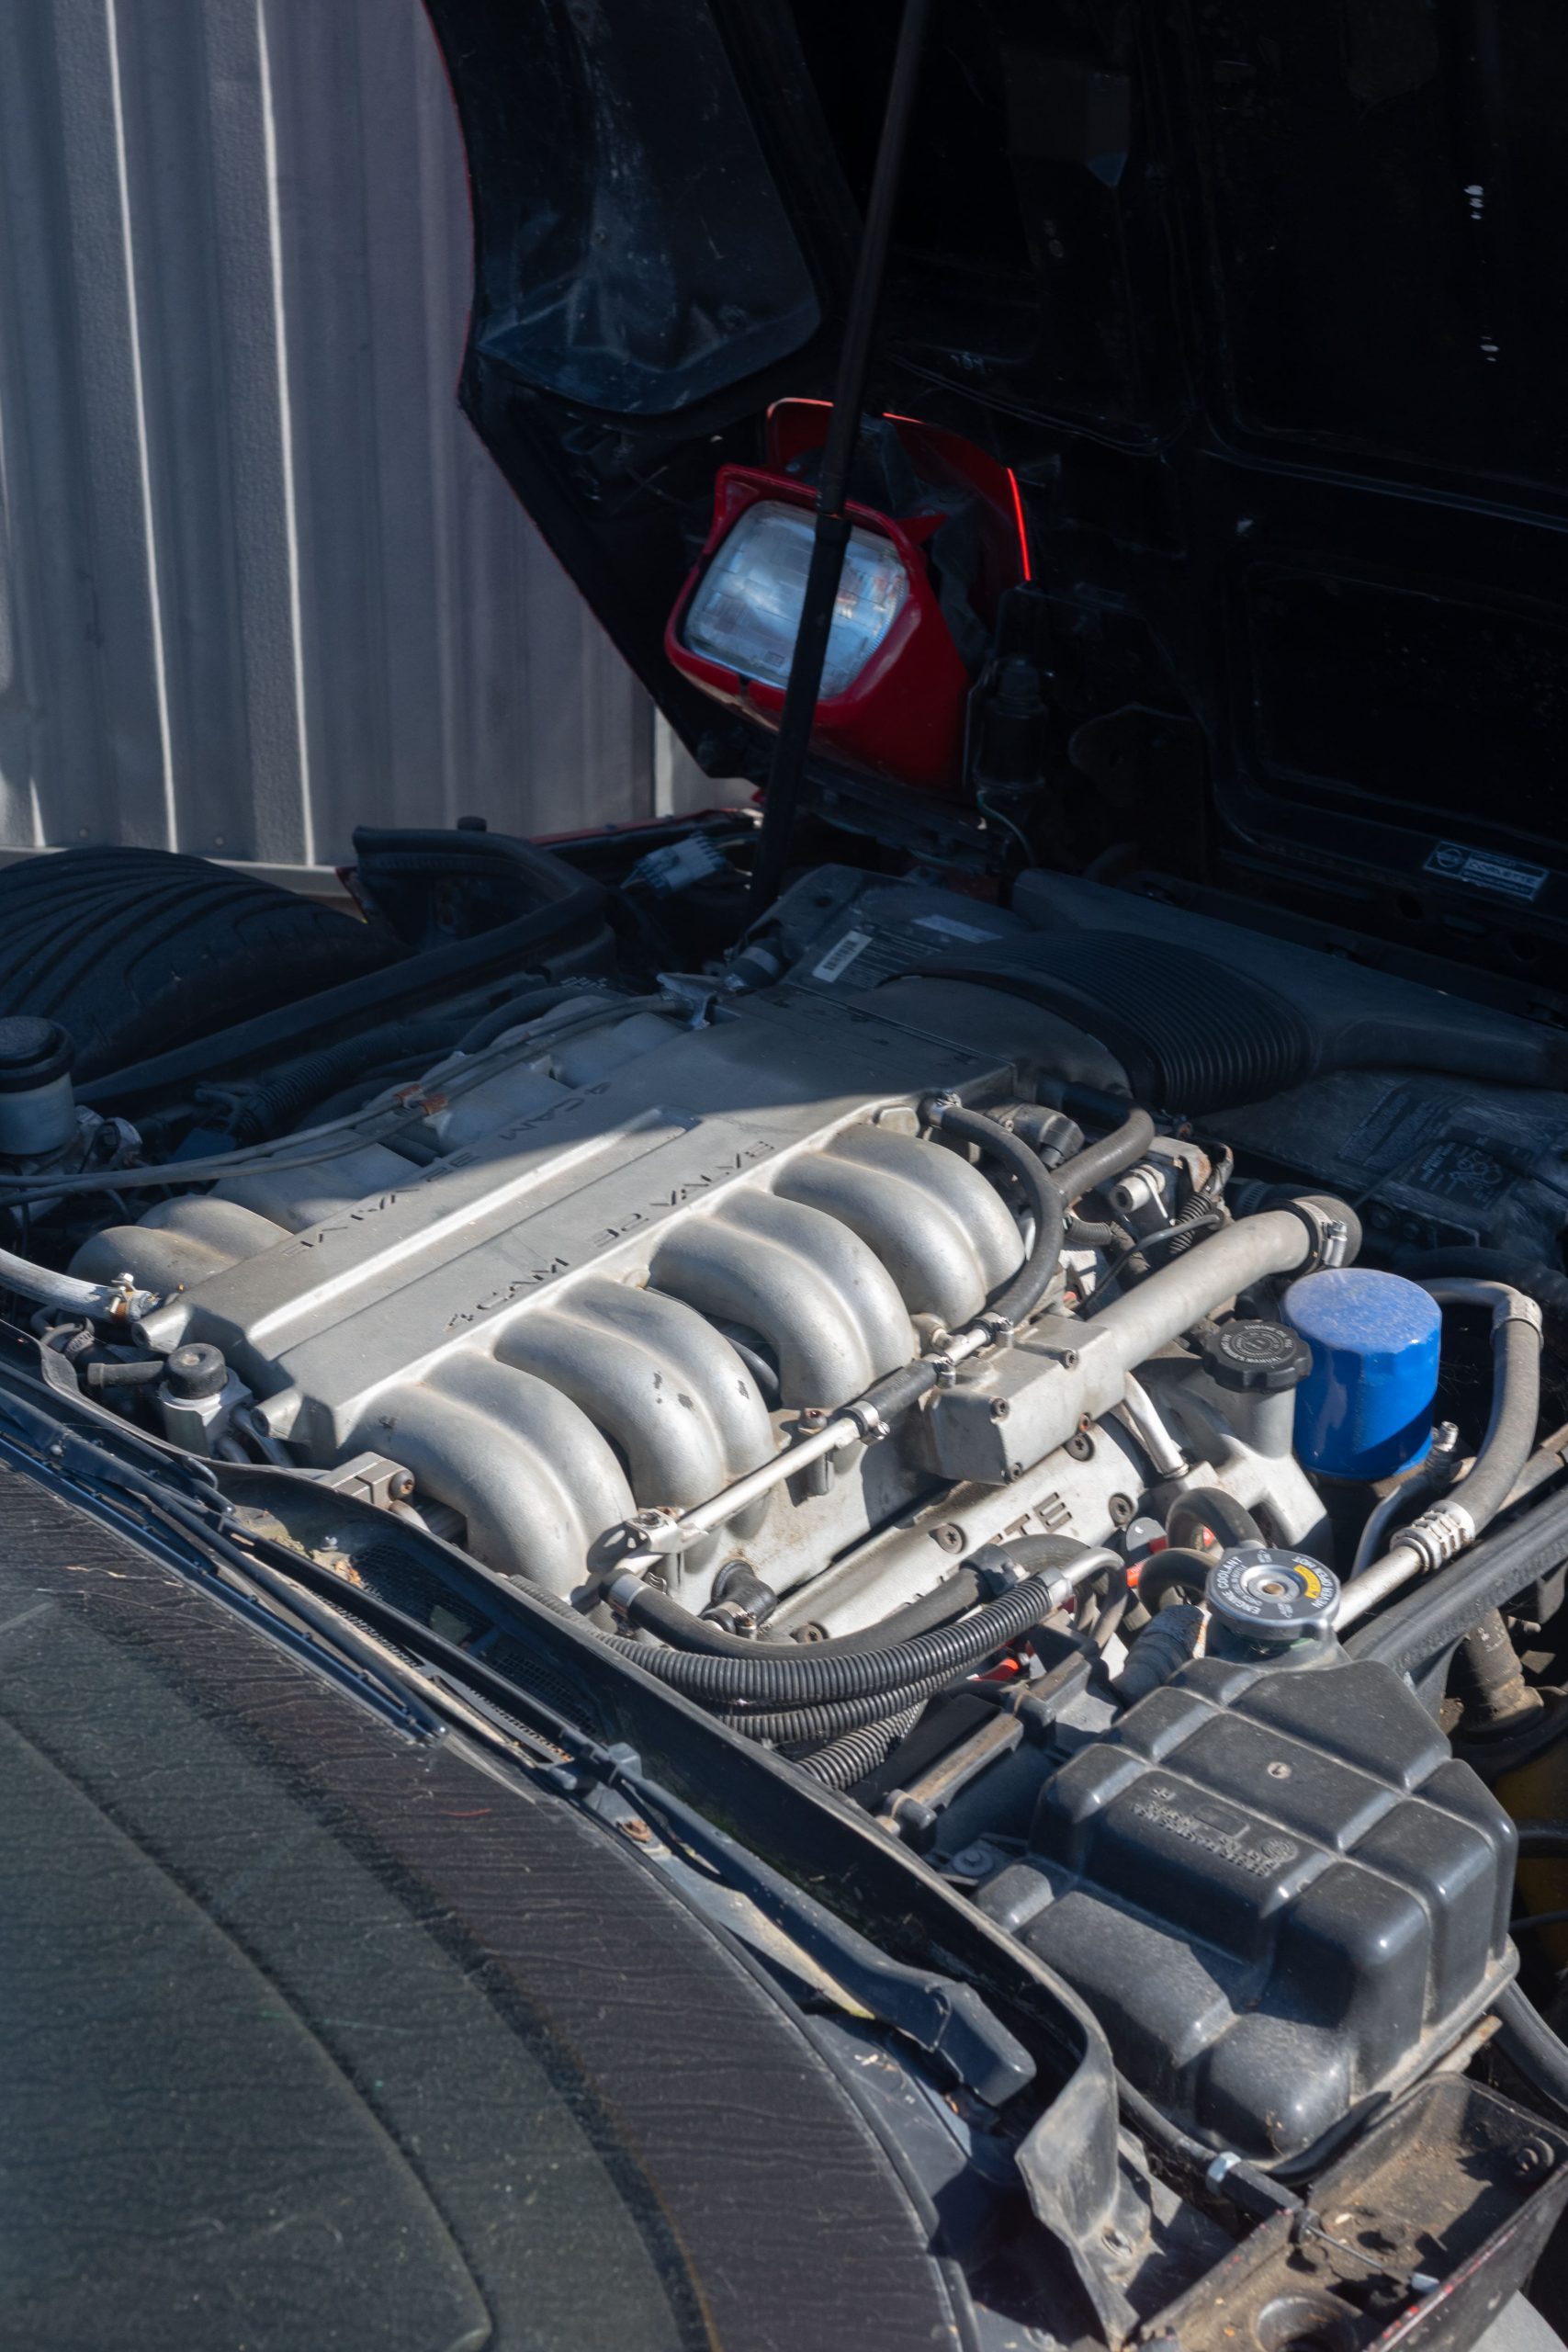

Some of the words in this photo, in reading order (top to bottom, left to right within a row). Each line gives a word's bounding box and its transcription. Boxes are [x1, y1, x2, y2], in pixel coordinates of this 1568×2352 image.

[499, 1097, 585, 1141] CAM
[476, 1257, 570, 1310] CAM
[594, 1213, 649, 1249] 32
[649, 1140, 774, 1206] VALVE
[1217, 1555, 1244, 1589] COOLANT
[1292, 1555, 1316, 1568] HOT
[1315, 1568, 1334, 1588] OPEN
[1222, 1589, 1262, 1614] ENGINE
[1311, 1588, 1334, 1609] NEVER
